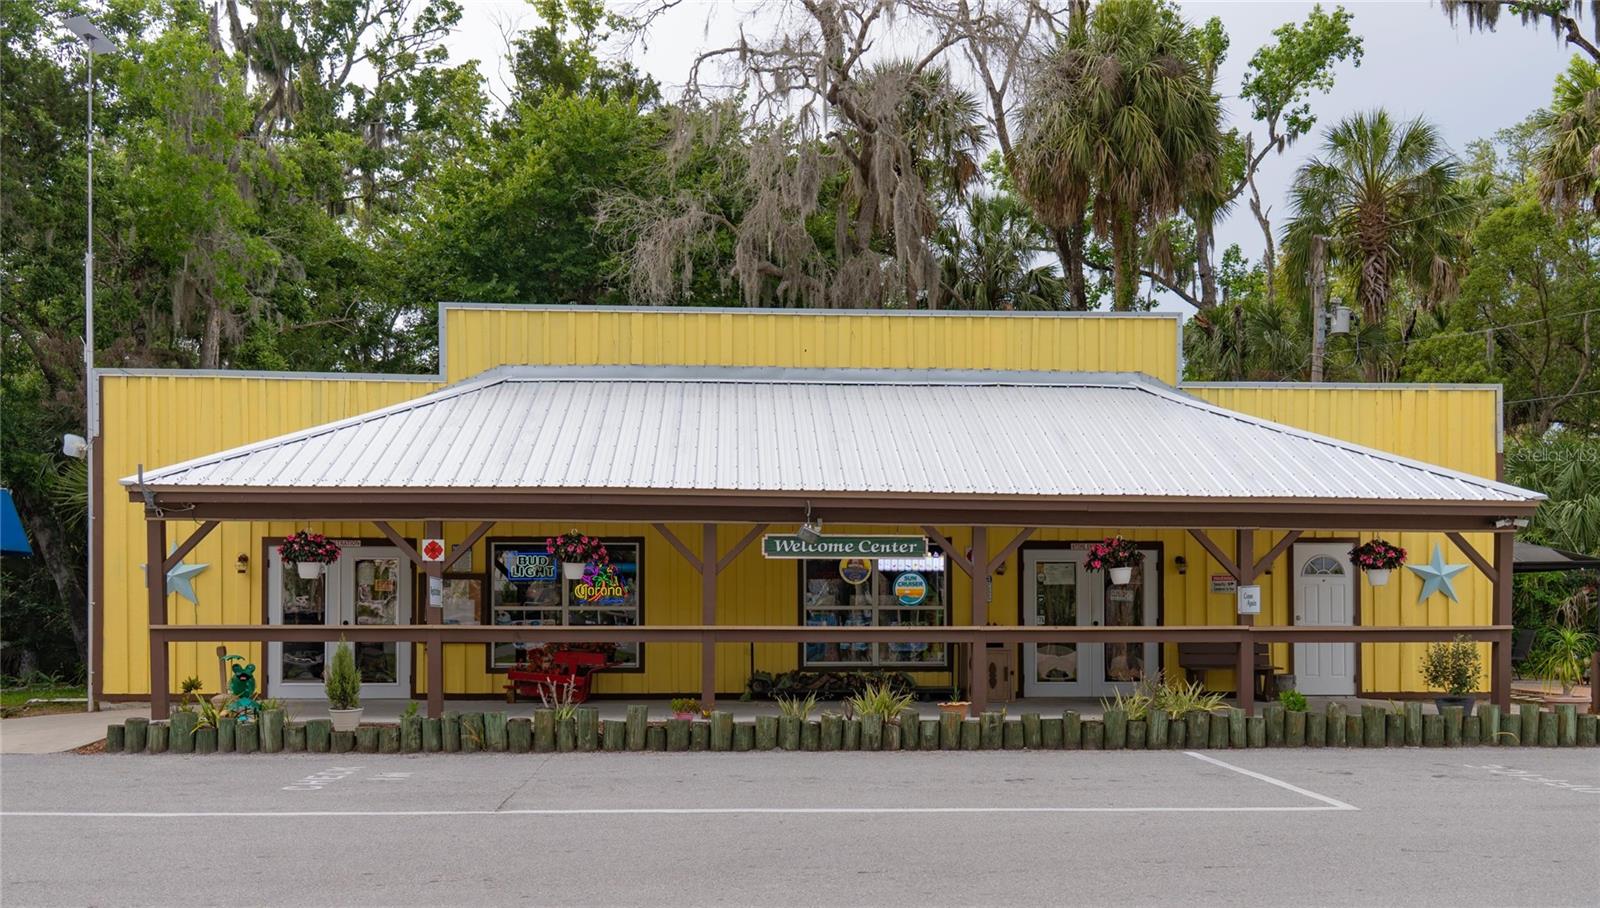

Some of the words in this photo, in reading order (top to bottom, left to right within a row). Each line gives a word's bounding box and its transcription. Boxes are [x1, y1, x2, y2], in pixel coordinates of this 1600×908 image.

[774, 539, 854, 554] Welcome
[858, 539, 918, 554] Center
[517, 555, 549, 567] BUD
[510, 566, 555, 578] LIGHT
[574, 583, 623, 601] Corona
